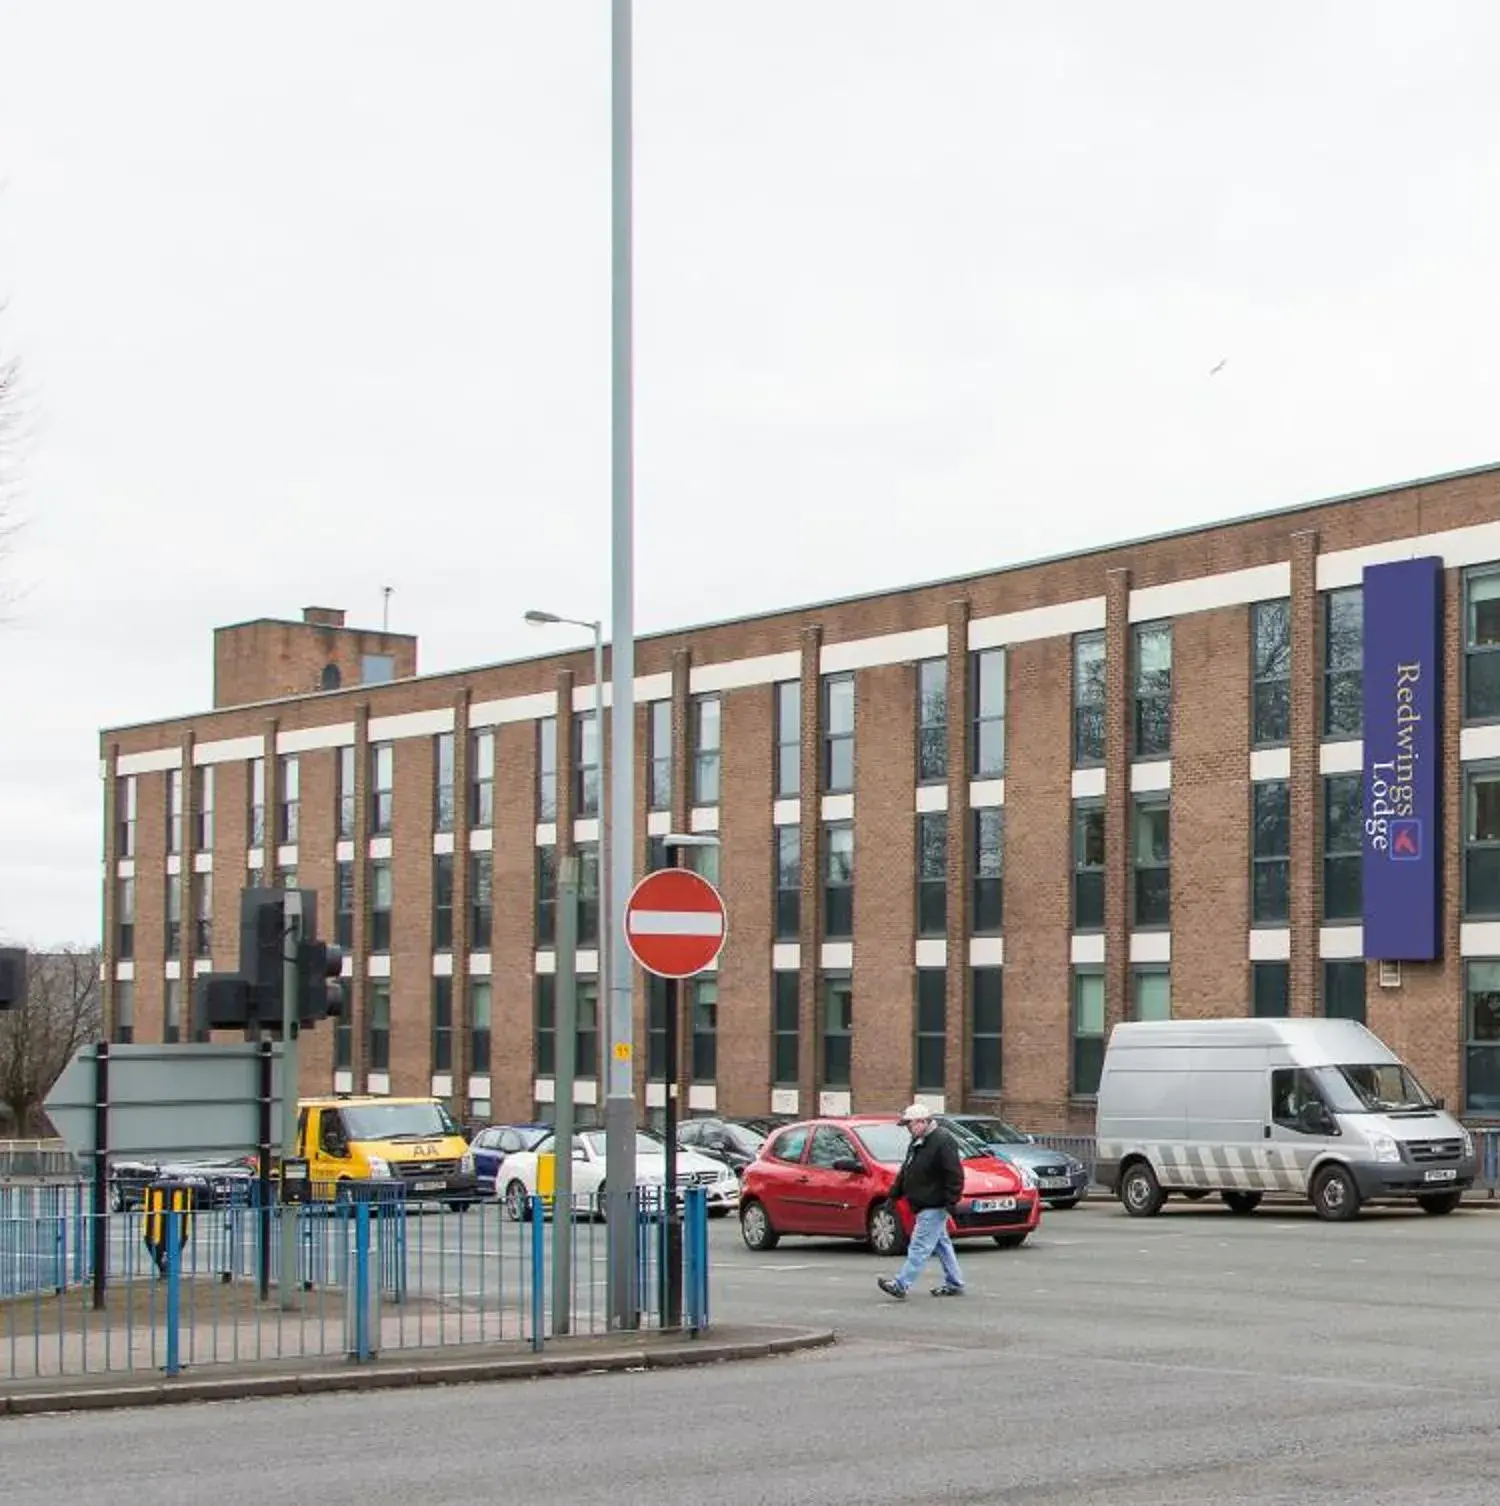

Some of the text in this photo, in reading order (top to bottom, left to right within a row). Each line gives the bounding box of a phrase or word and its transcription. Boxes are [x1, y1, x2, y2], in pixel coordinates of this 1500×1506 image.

[1389, 662, 1421, 816] Redwings
[1365, 761, 1395, 851] Lodge
[413, 1145, 439, 1158] AA
